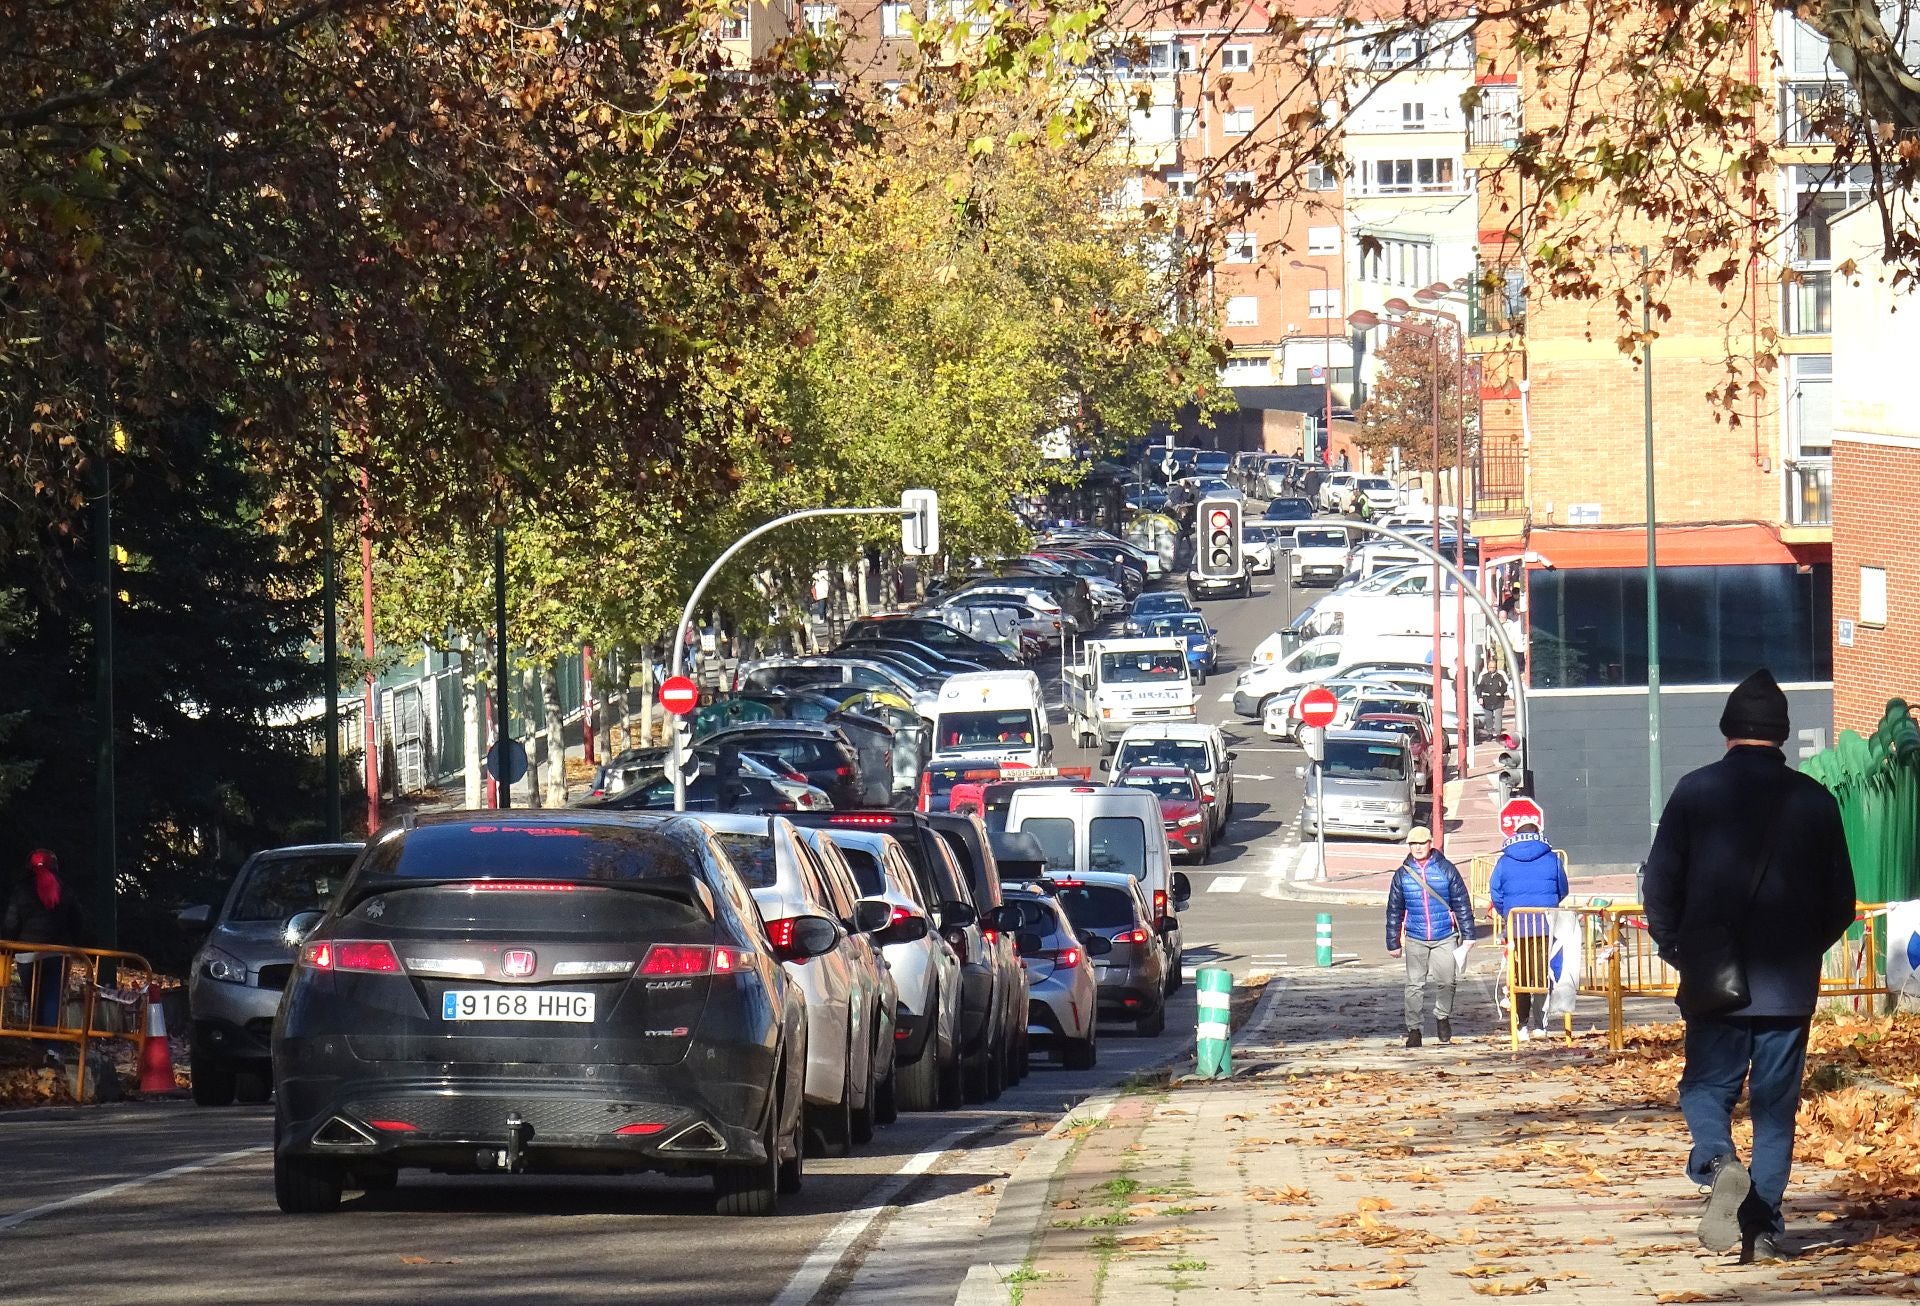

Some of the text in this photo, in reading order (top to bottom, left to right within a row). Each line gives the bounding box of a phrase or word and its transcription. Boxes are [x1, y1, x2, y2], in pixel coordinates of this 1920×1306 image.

[1503, 815, 1539, 828] STOP
[645, 980, 692, 990] CIVIC
[462, 995, 587, 1017] 9168 HHG
